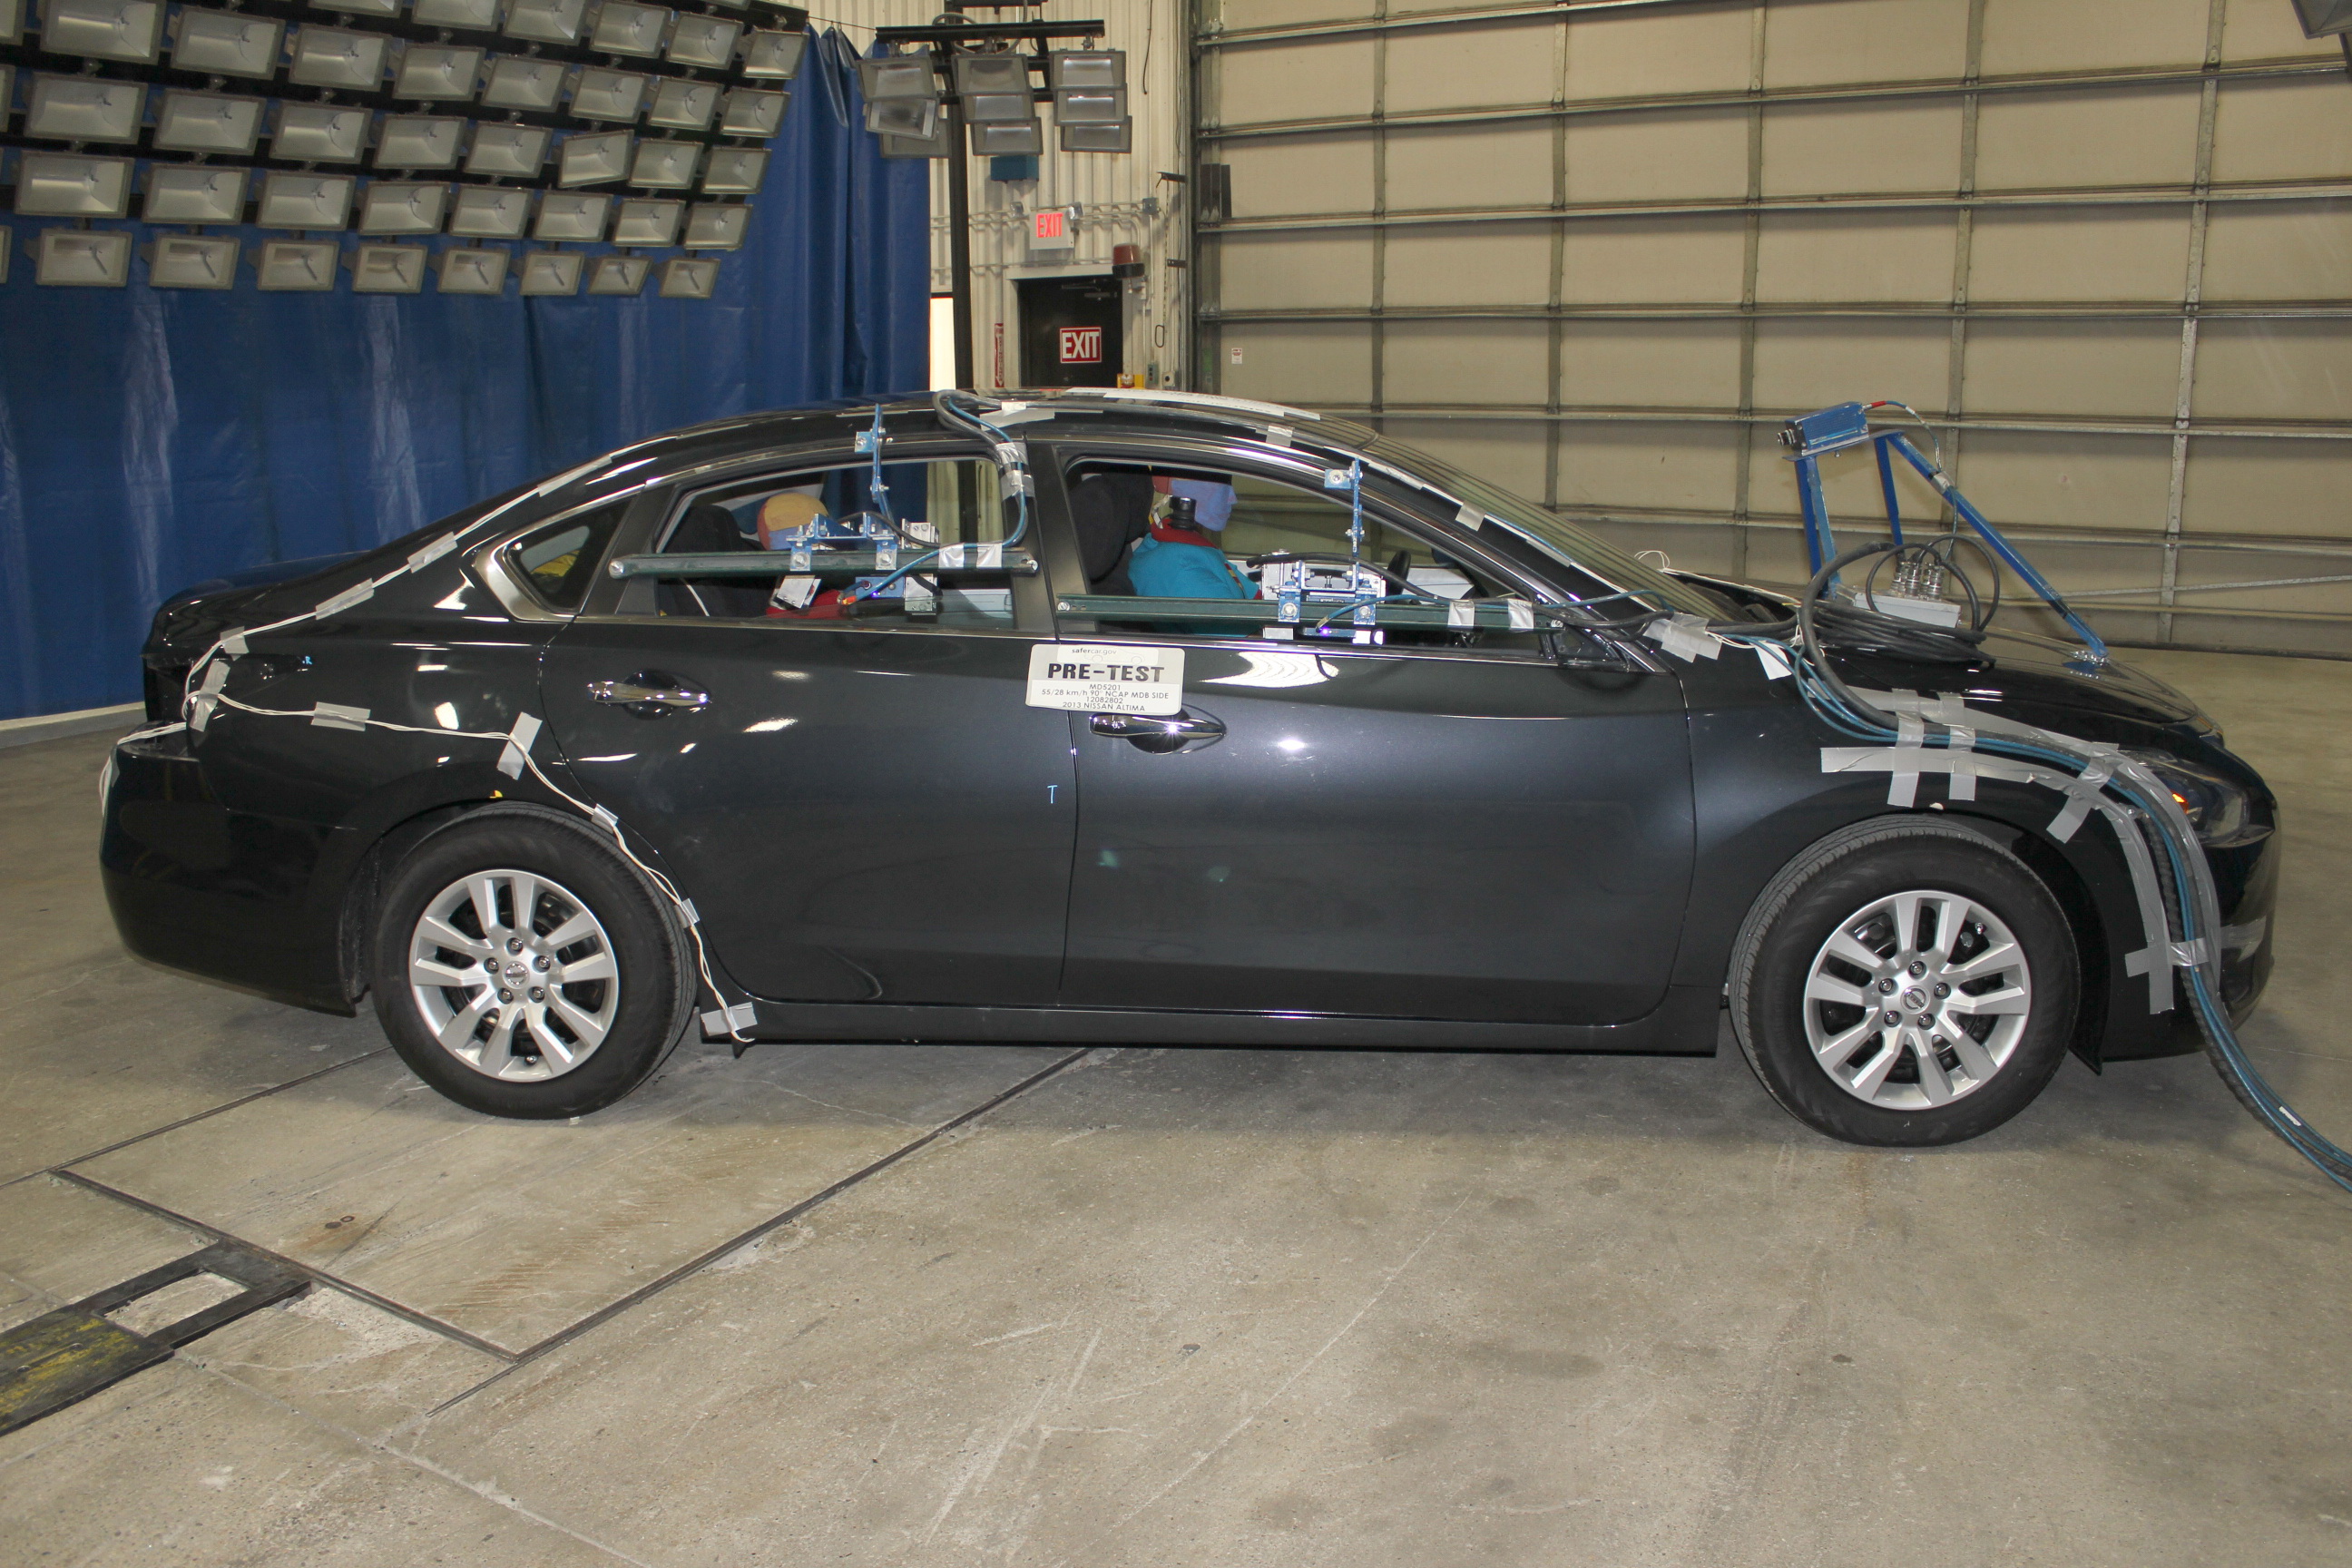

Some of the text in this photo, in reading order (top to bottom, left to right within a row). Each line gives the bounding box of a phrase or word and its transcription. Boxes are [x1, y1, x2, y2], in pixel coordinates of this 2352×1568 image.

[1036, 212, 1063, 239] EXIT
[1063, 331, 1100, 358] EXIT
[1047, 663, 1164, 682] PRE-TEST
[1086, 696, 1123, 704] 12082802
[1047, 784, 1058, 804] T
